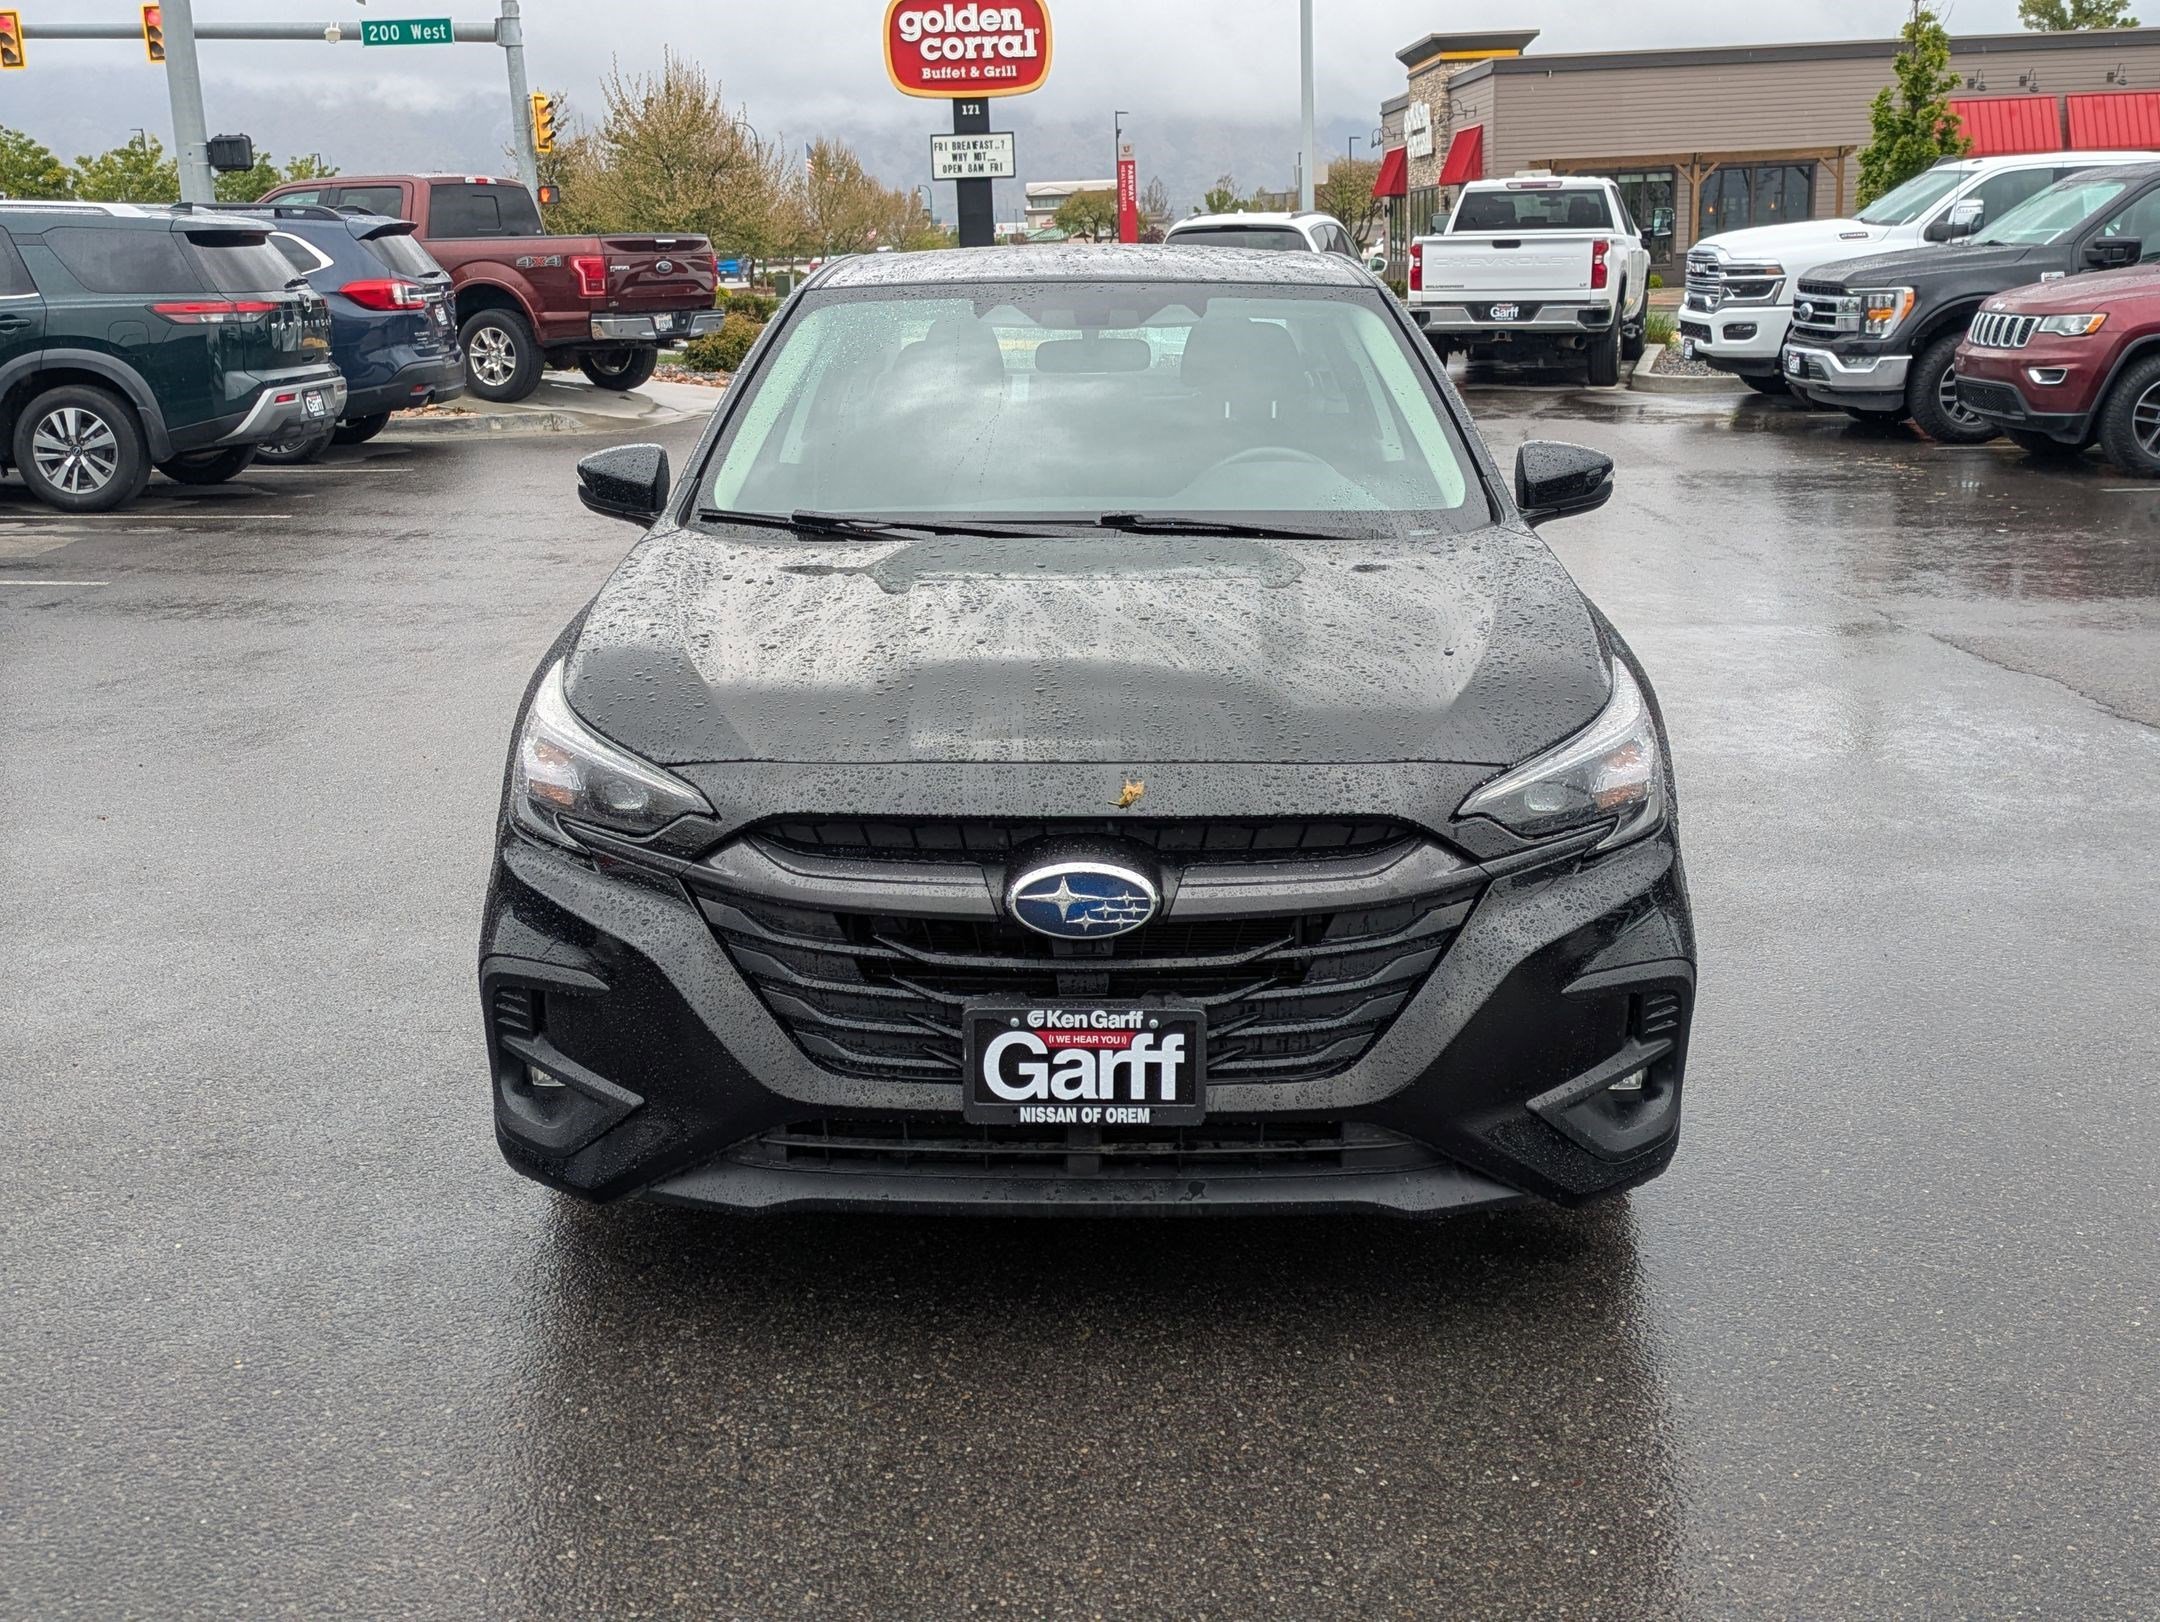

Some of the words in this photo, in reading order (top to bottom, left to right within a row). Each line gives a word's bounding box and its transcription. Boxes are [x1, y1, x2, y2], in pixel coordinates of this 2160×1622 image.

[898, 3, 1024, 42] golden
[368, 24, 400, 41] 200
[410, 23, 446, 40] West
[920, 28, 1037, 61] corral
[922, 66, 966, 79] Buffet
[969, 66, 980, 78] &
[984, 65, 1017, 77] Grill
[961, 104, 980, 115] 171
[934, 141, 948, 151] FRI
[952, 152, 968, 162] WHY
[942, 164, 962, 174] OPEN
[968, 163, 984, 173] 8AM
[990, 162, 1003, 172] FRI
[1127, 164, 1135, 202] PARKWAY
[1490, 306, 1520, 318] Garff
[1046, 1010, 1088, 1028] Ken
[1090, 1010, 1144, 1029] Garff
[1056, 1035, 1071, 1044] WE
[1072, 1035, 1099, 1044] HEAR
[1100, 1035, 1121, 1044] YOU
[983, 1030, 1185, 1101] Garff
[1020, 1107, 1077, 1123] NISSAN
[1081, 1107, 1101, 1123] OF
[1105, 1107, 1150, 1123] OREM
